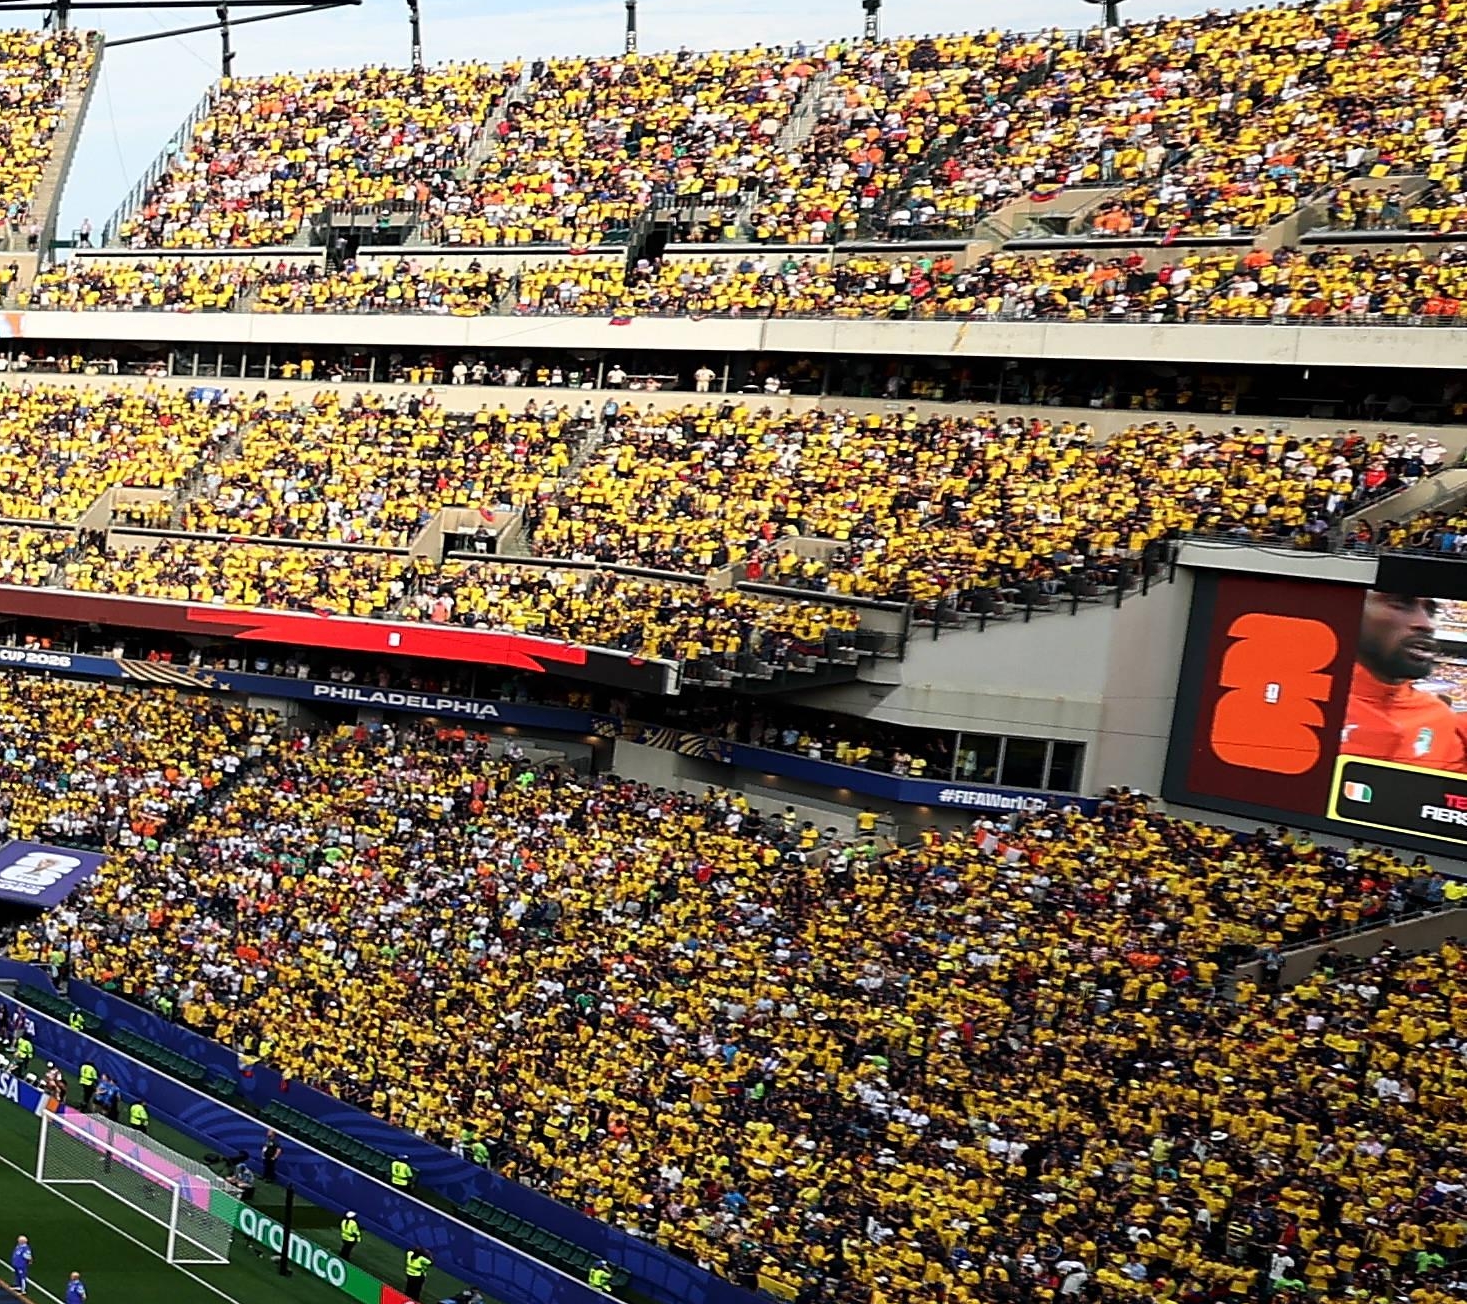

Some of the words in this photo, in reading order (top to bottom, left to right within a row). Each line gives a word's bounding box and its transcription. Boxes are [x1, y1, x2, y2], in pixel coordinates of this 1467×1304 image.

[0, 648, 25, 661] CUP
[26, 652, 71, 667] 2026
[313, 684, 498, 717] PHILADELPHIA
[239, 1207, 347, 1289] aramco
